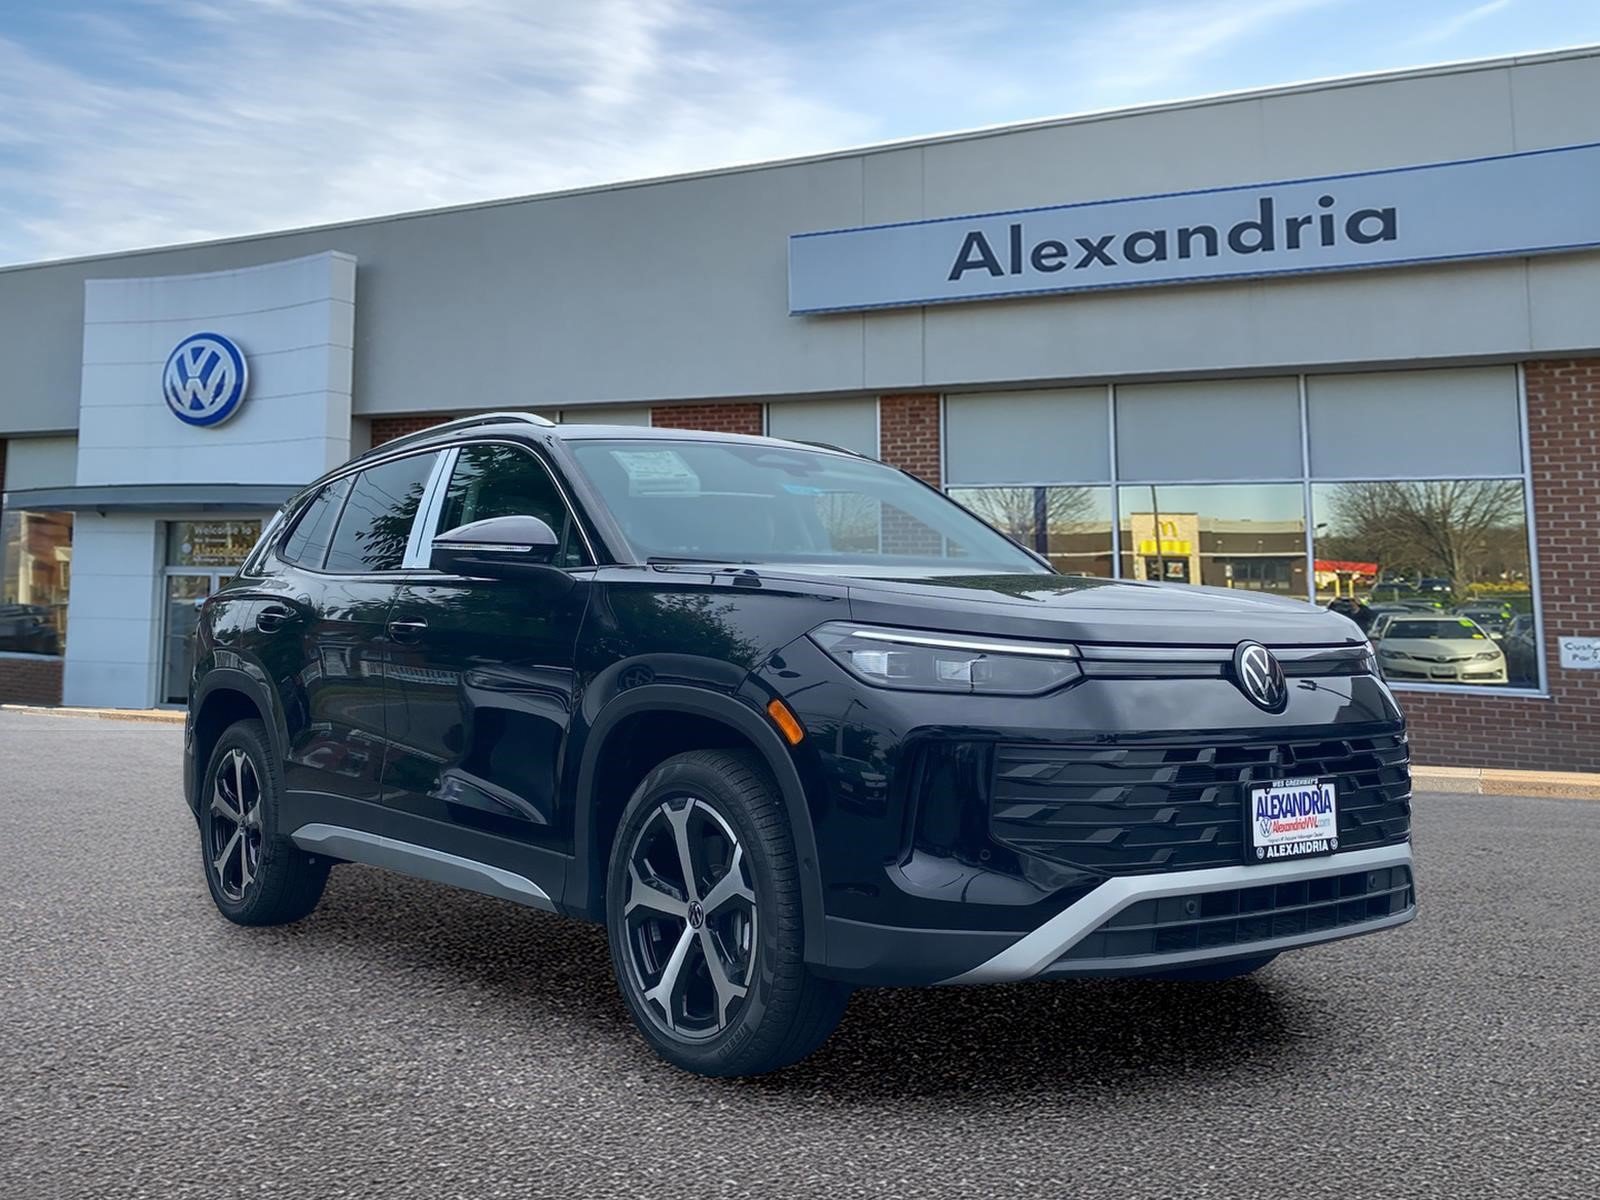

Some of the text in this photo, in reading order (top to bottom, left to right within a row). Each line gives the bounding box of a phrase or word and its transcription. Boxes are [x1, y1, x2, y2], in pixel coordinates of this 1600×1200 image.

[947, 194, 1398, 282] Alexandria
[165, 337, 240, 420] VW
[1240, 643, 1284, 706] VW
[1256, 789, 1332, 821] ALEXANDRIA
[1266, 839, 1329, 858] ALEXANDRIA
